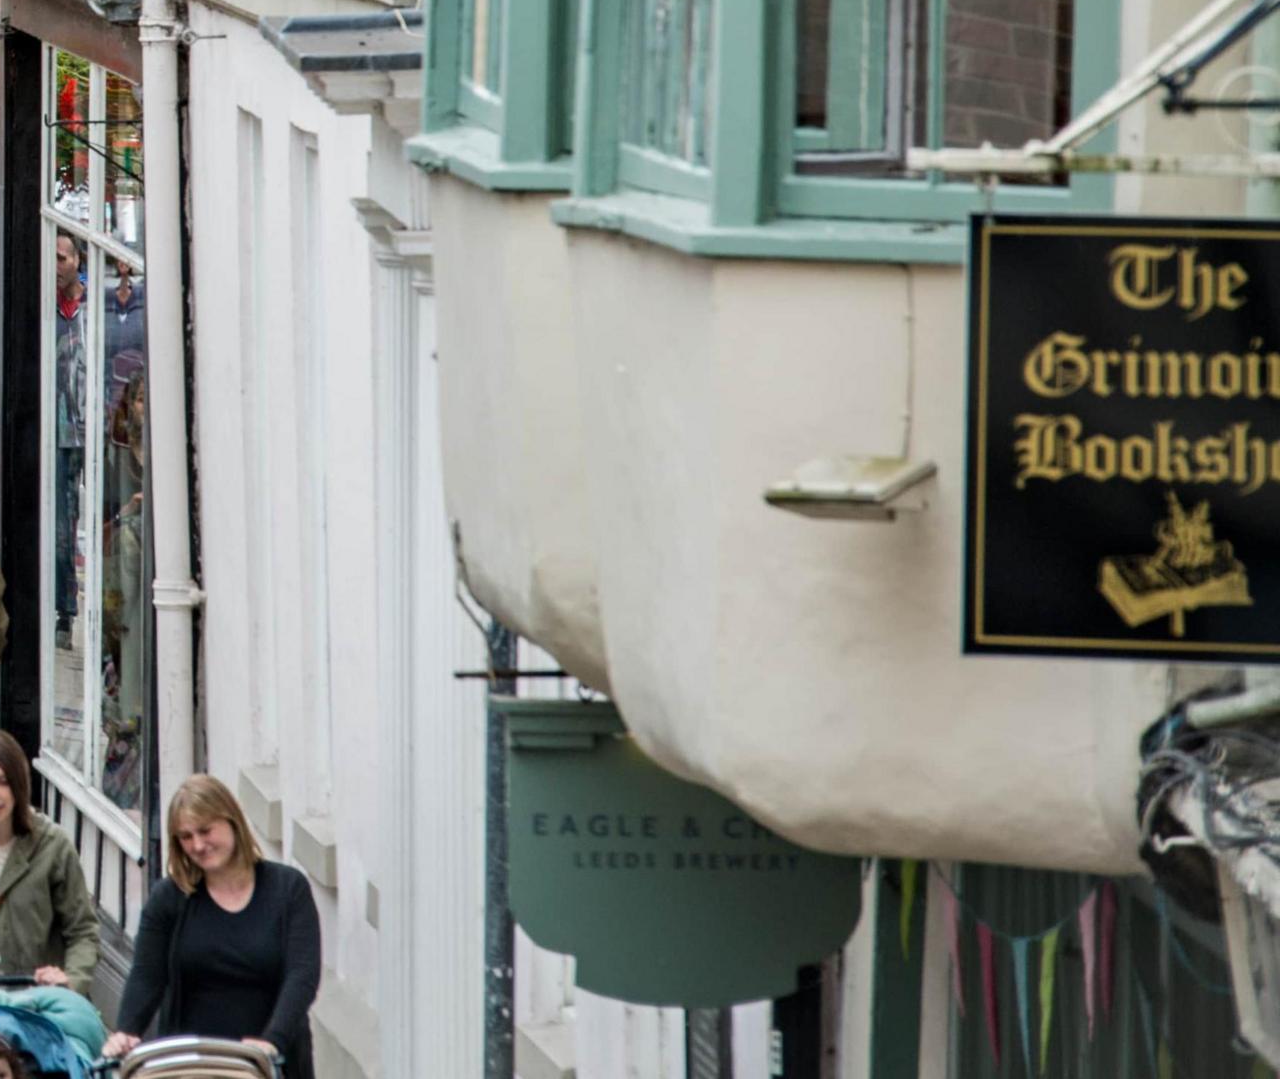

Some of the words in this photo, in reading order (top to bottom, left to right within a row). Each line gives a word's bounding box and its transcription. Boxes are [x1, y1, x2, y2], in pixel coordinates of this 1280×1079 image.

[1108, 243, 1249, 322] The
[1013, 413, 1280, 497] Booksh
[532, 813, 657, 839] EAGLE
[680, 816, 703, 839] &
[574, 851, 657, 869] LEEDS
[673, 852, 801, 872] BREWERY
